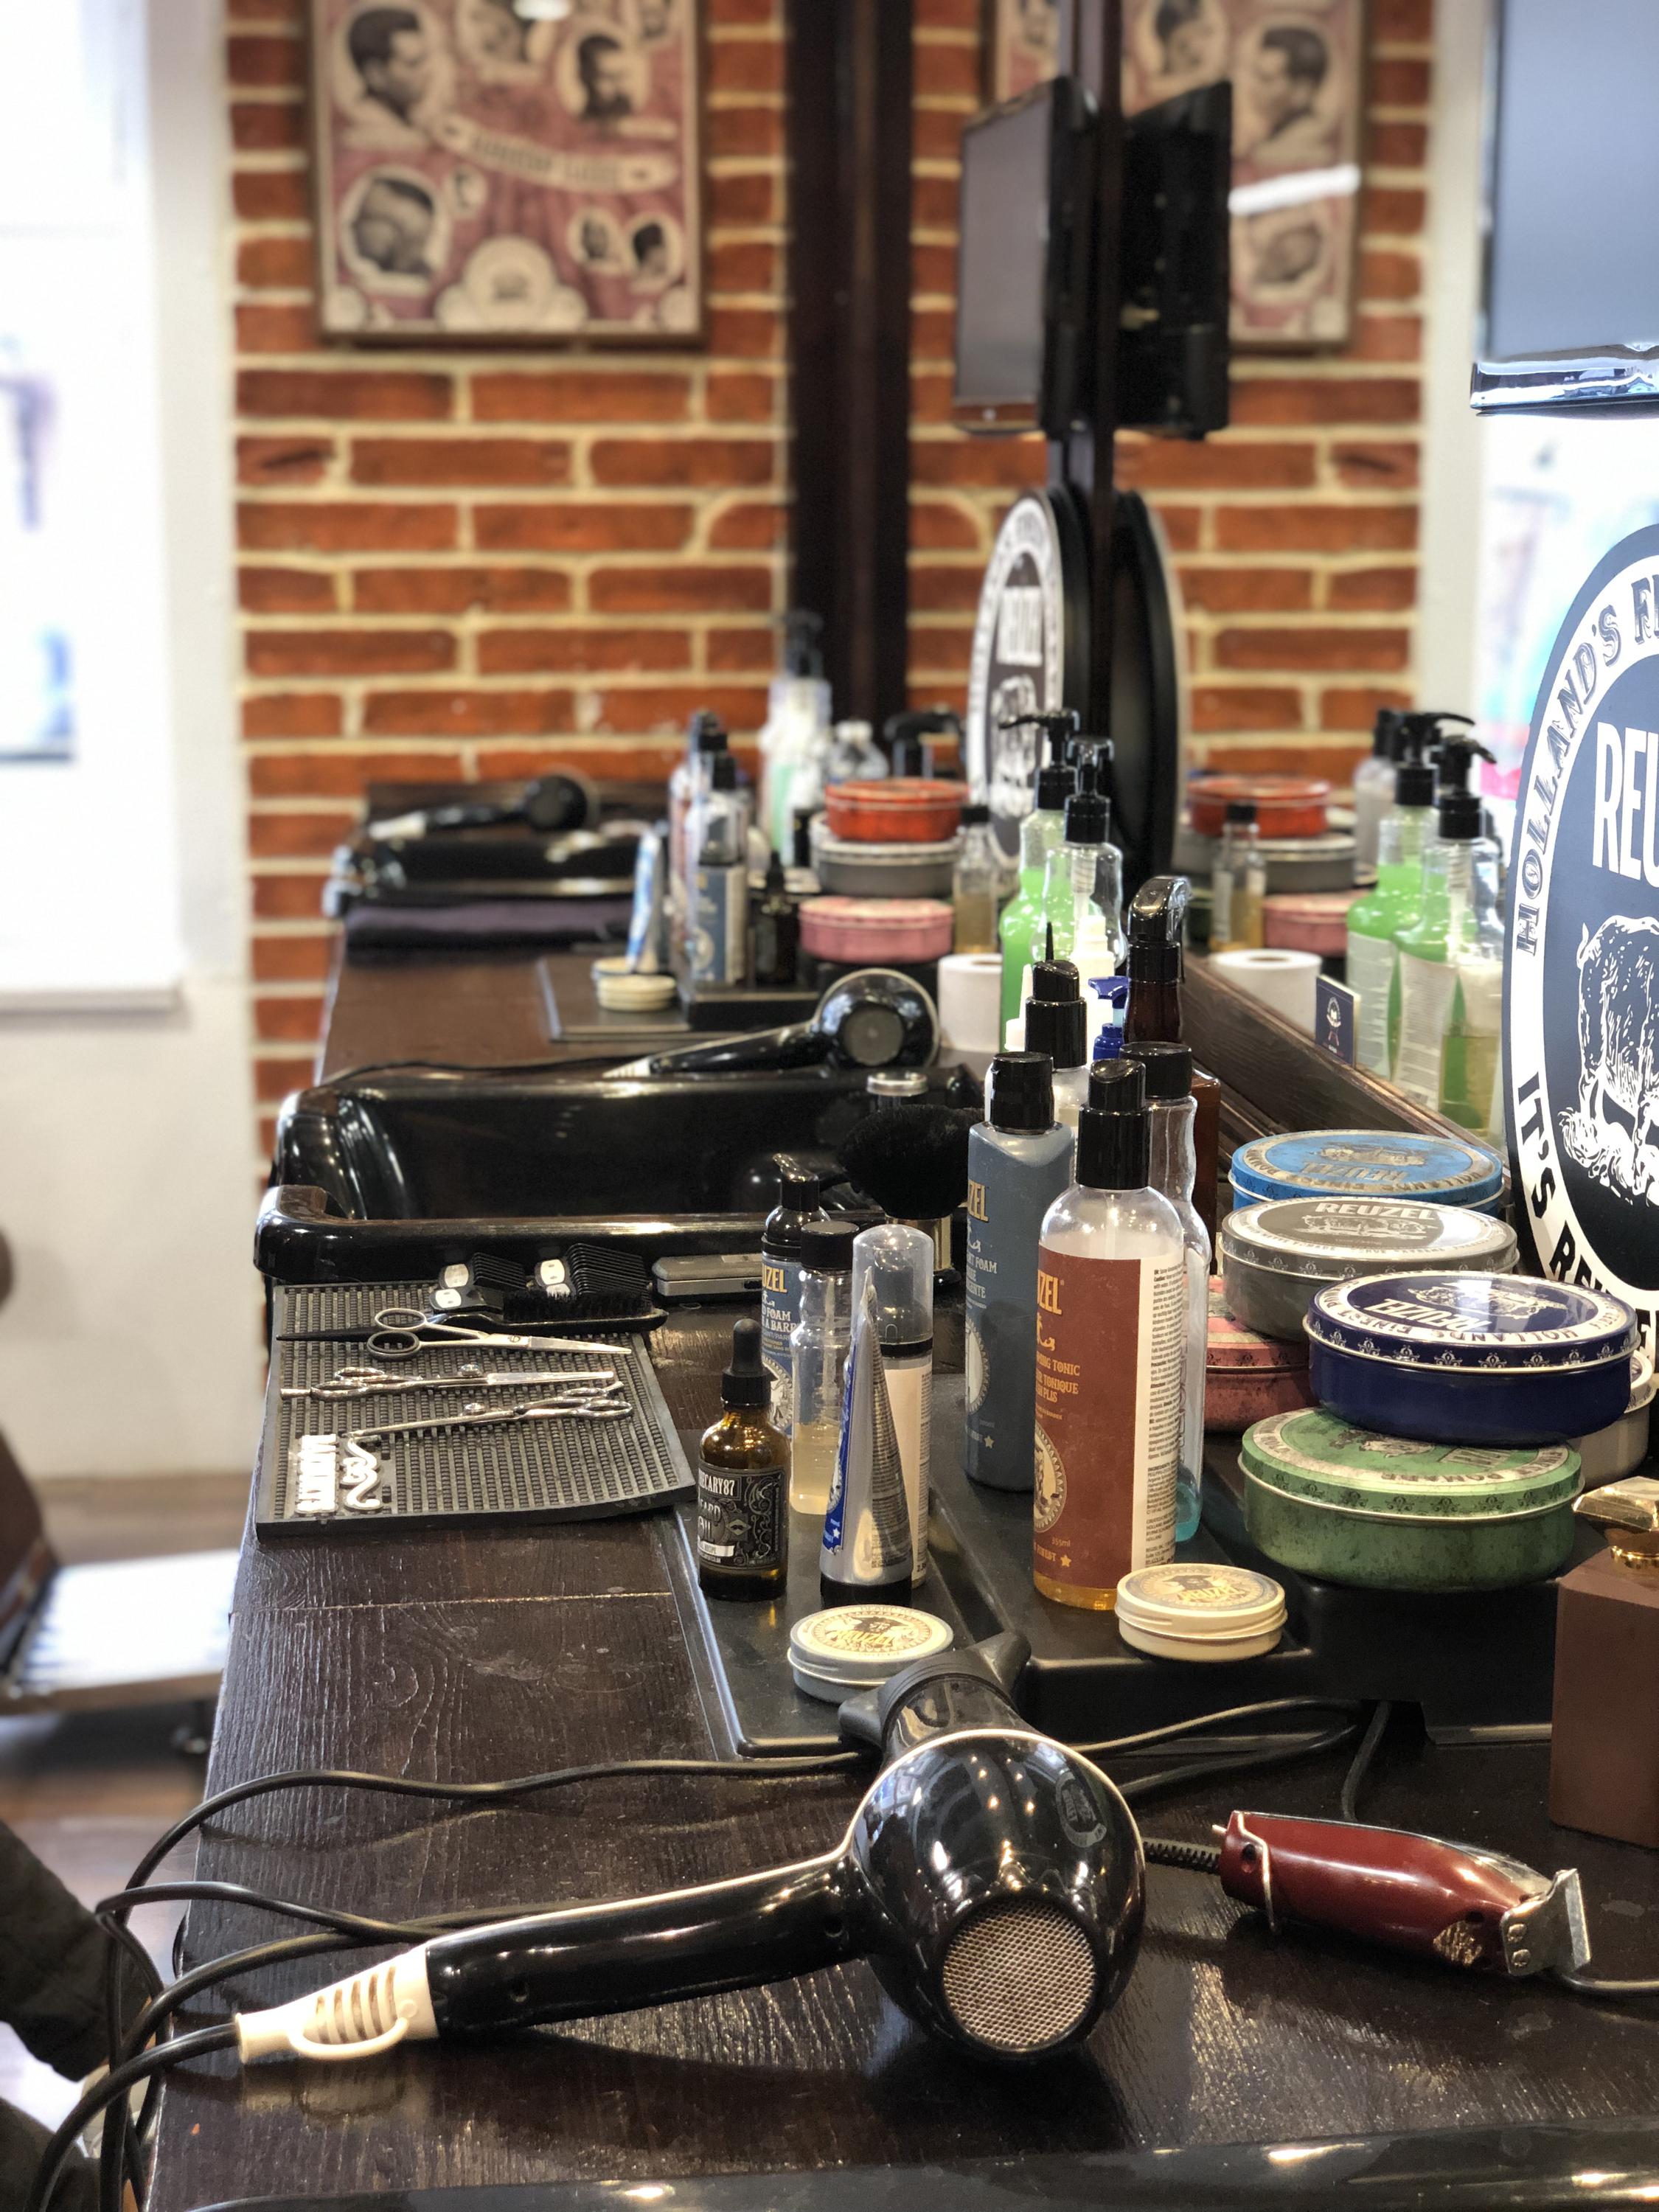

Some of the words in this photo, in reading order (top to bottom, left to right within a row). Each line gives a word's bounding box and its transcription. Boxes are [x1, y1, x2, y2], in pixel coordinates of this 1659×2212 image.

[1517, 603, 1622, 956] HOLLAND'S
[1517, 1072, 1557, 1219] IT'S
[1315, 1203, 1438, 1220] REUZEL
[975, 1256, 997, 1274] FOAM
[767, 1307, 791, 1321] FOAM
[1364, 1298, 1492, 1332] REUZEL
[1052, 1359, 1080, 1377] TONIC
[1043, 1374, 1079, 1395] TONIQUE
